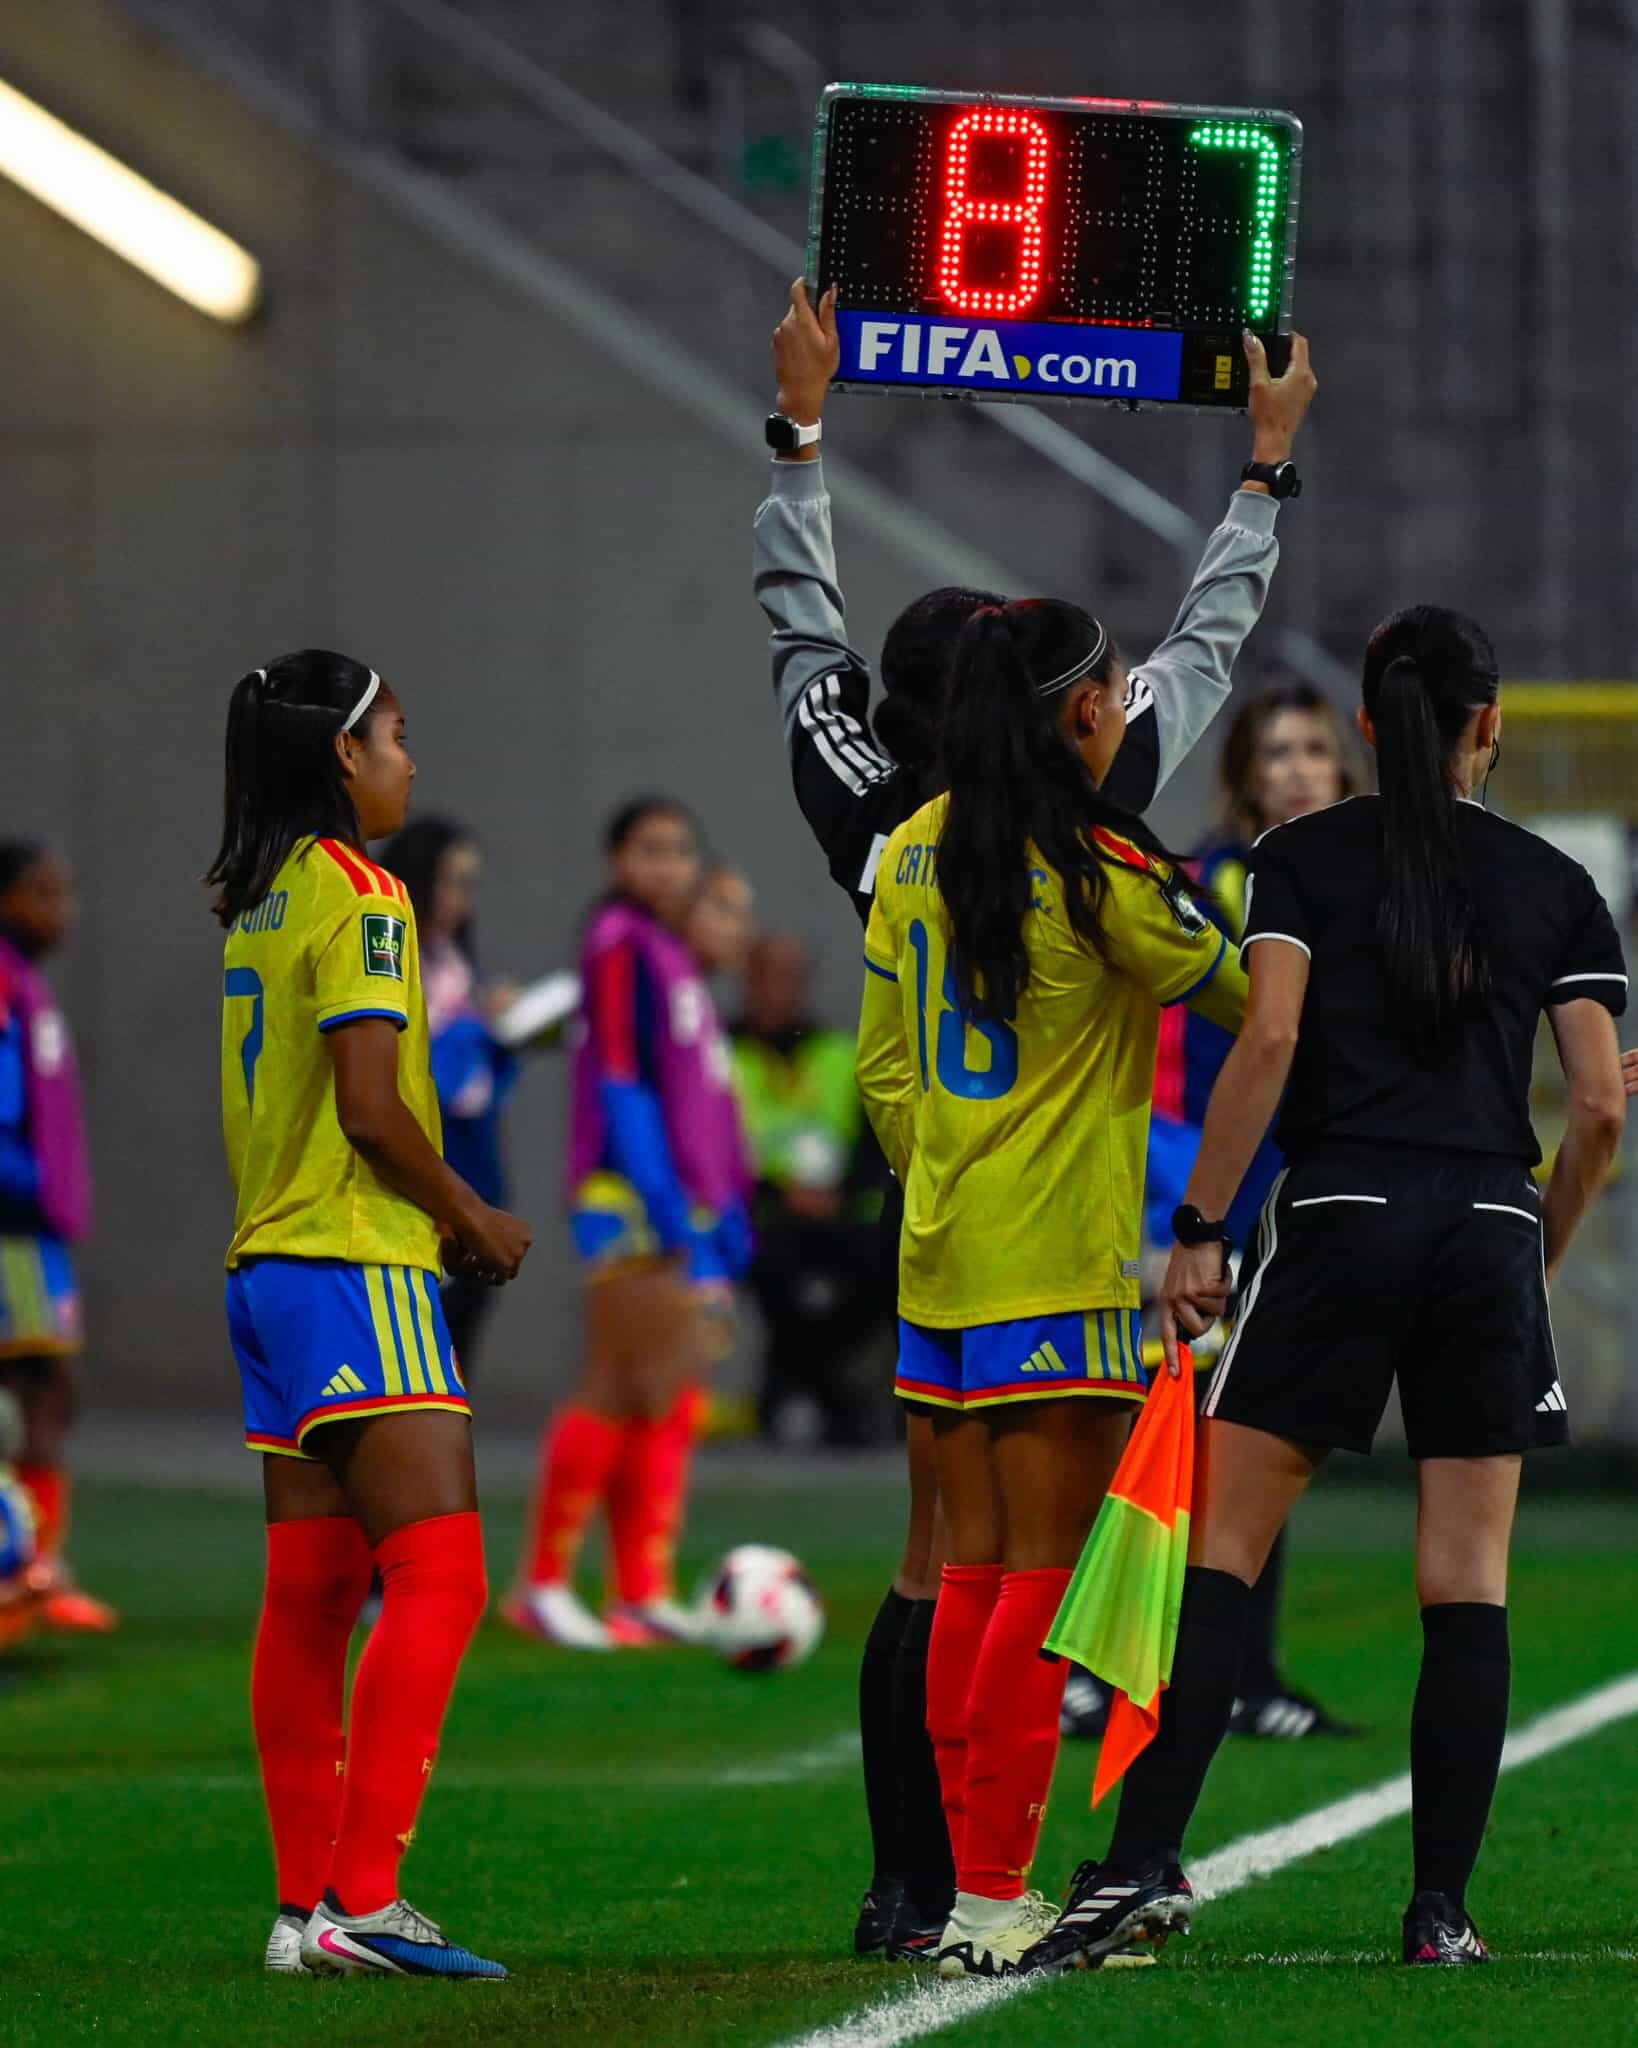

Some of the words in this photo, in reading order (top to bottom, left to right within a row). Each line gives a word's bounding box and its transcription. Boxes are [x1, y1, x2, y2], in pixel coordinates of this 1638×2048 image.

[940, 110, 1049, 313] 8
[1189, 126, 1279, 320] 7
[224, 967, 265, 1107] 7
